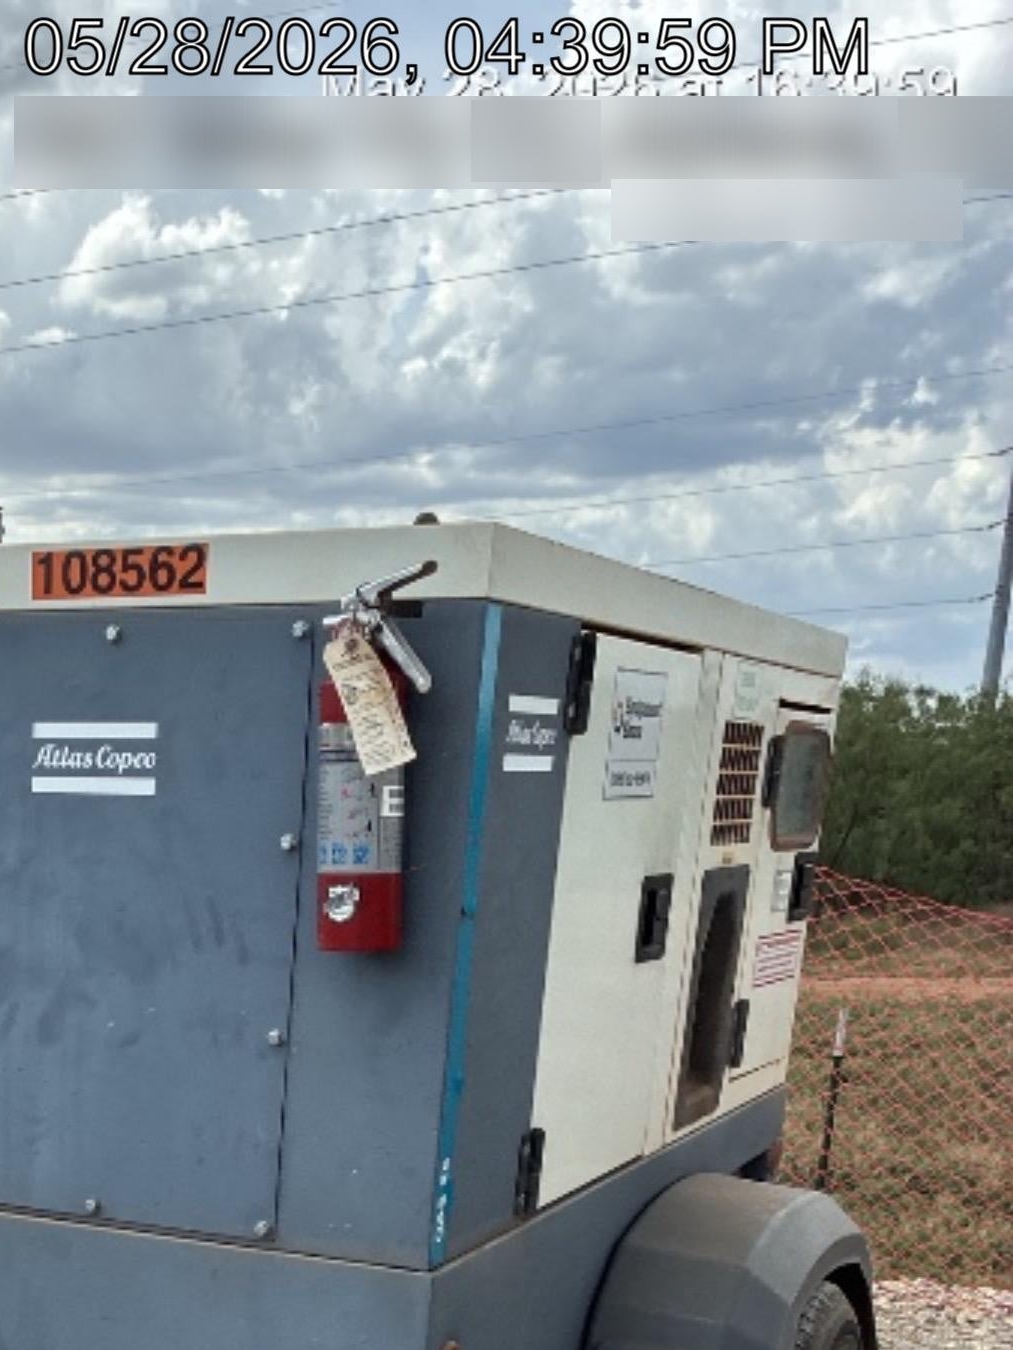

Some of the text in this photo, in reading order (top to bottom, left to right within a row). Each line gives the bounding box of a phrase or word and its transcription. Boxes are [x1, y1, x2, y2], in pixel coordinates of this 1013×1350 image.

[36, 544, 207, 595] 108562
[31, 743, 157, 775] Atlas Copco
